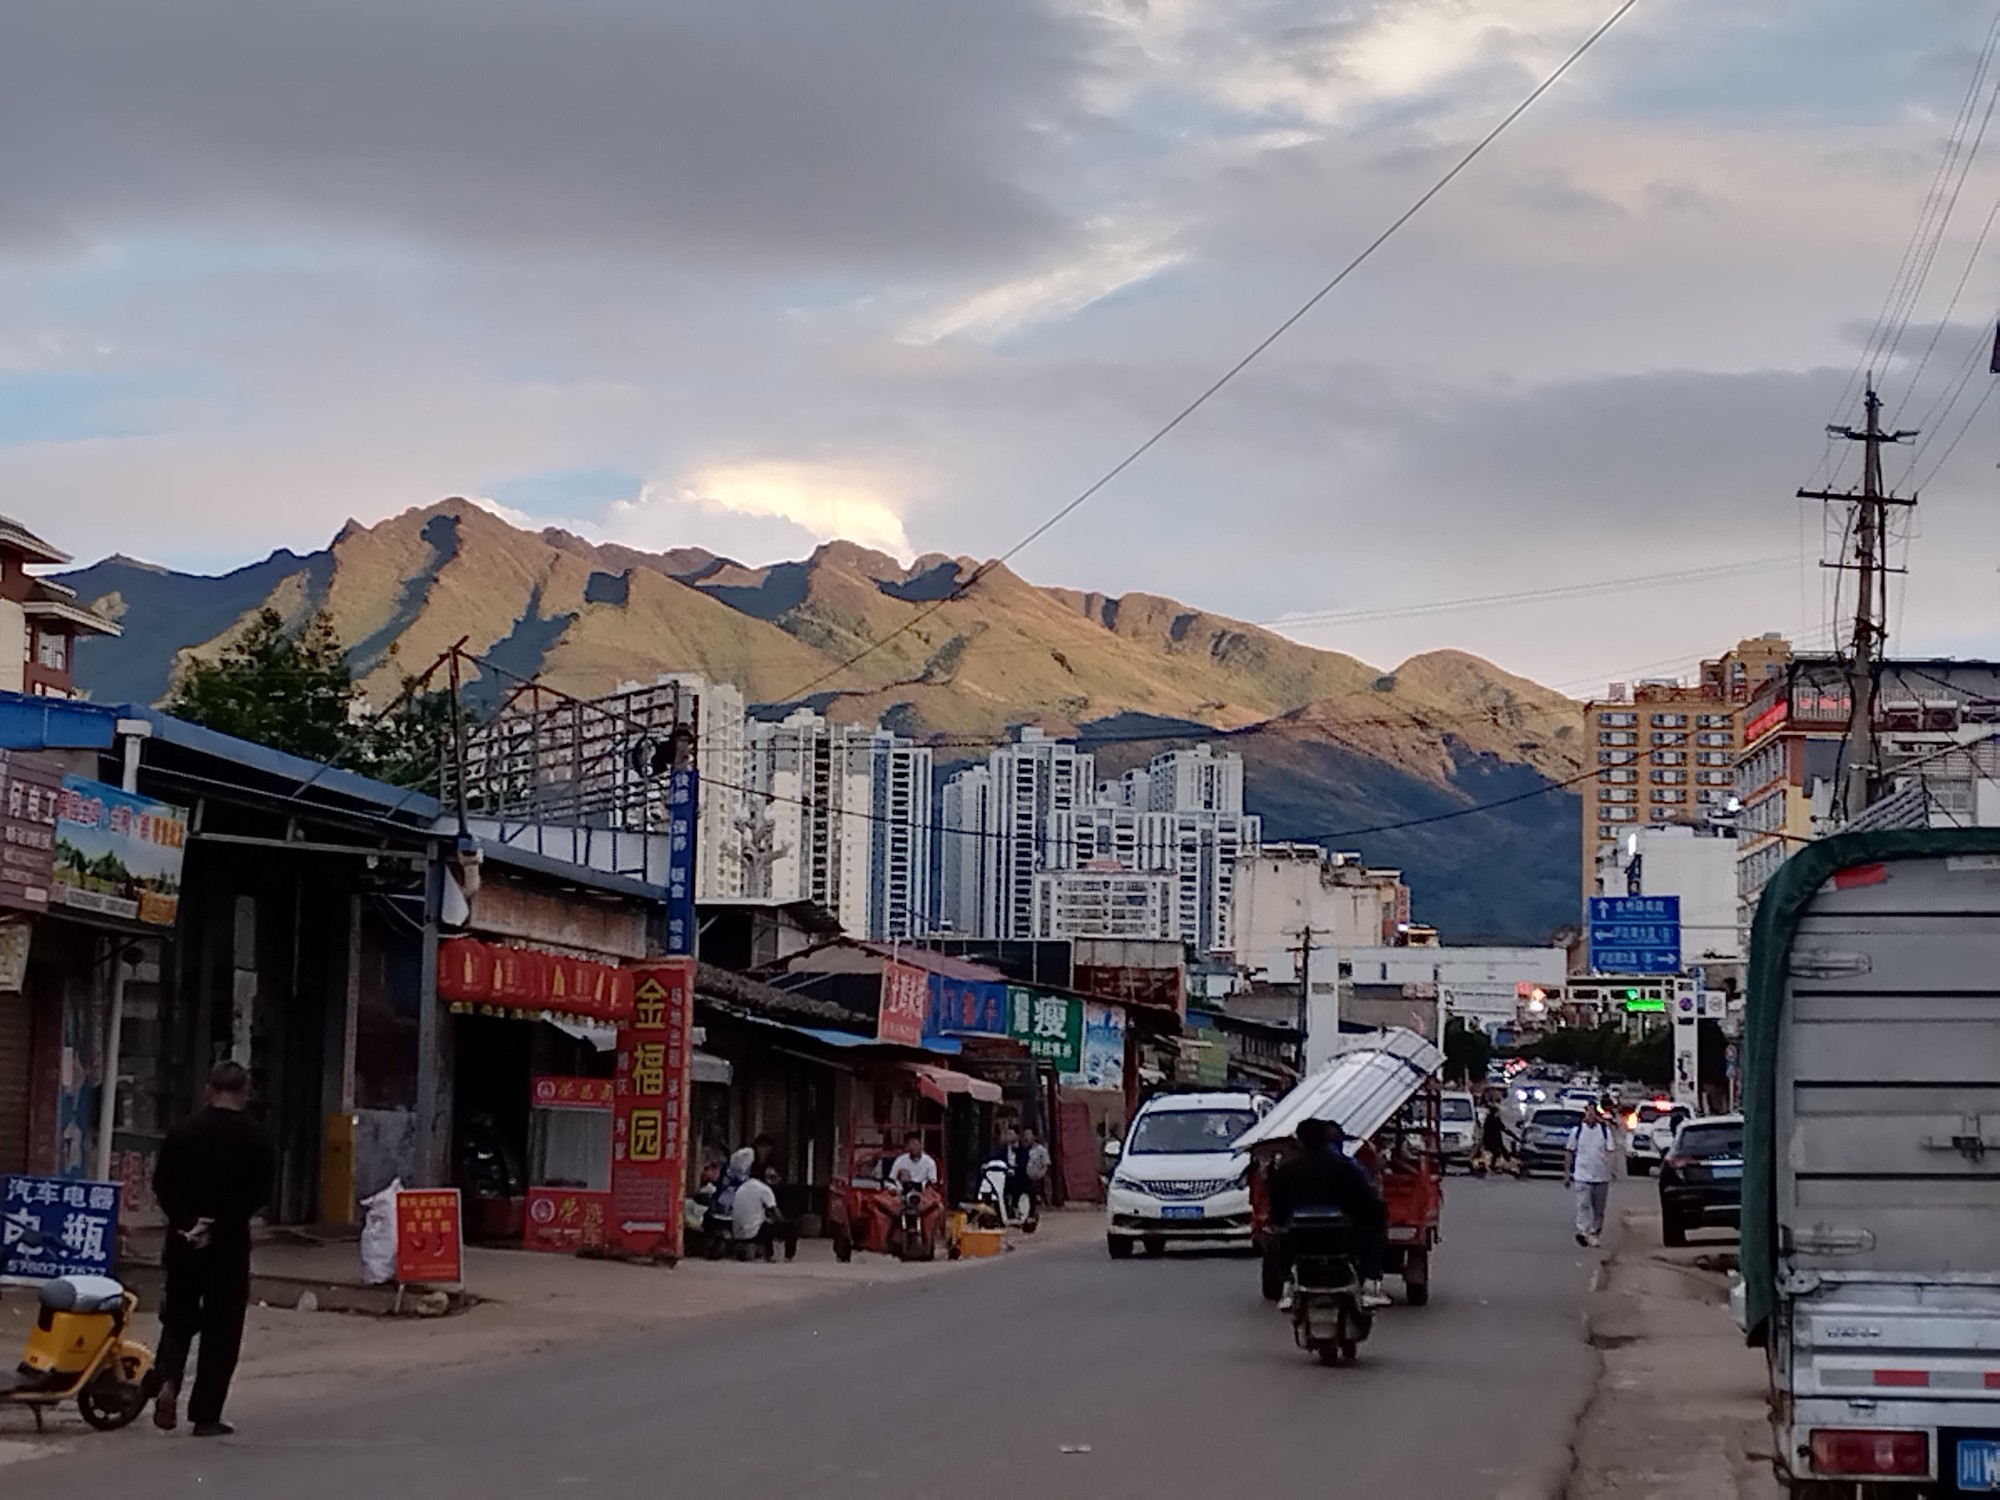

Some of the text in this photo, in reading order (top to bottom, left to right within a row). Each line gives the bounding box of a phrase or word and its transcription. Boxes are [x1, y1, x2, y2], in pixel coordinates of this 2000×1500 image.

[1033, 995, 1069, 1039] 瘦
[629, 977, 667, 1162] 金福园
[7, 1179, 115, 1210] 汽车电器
